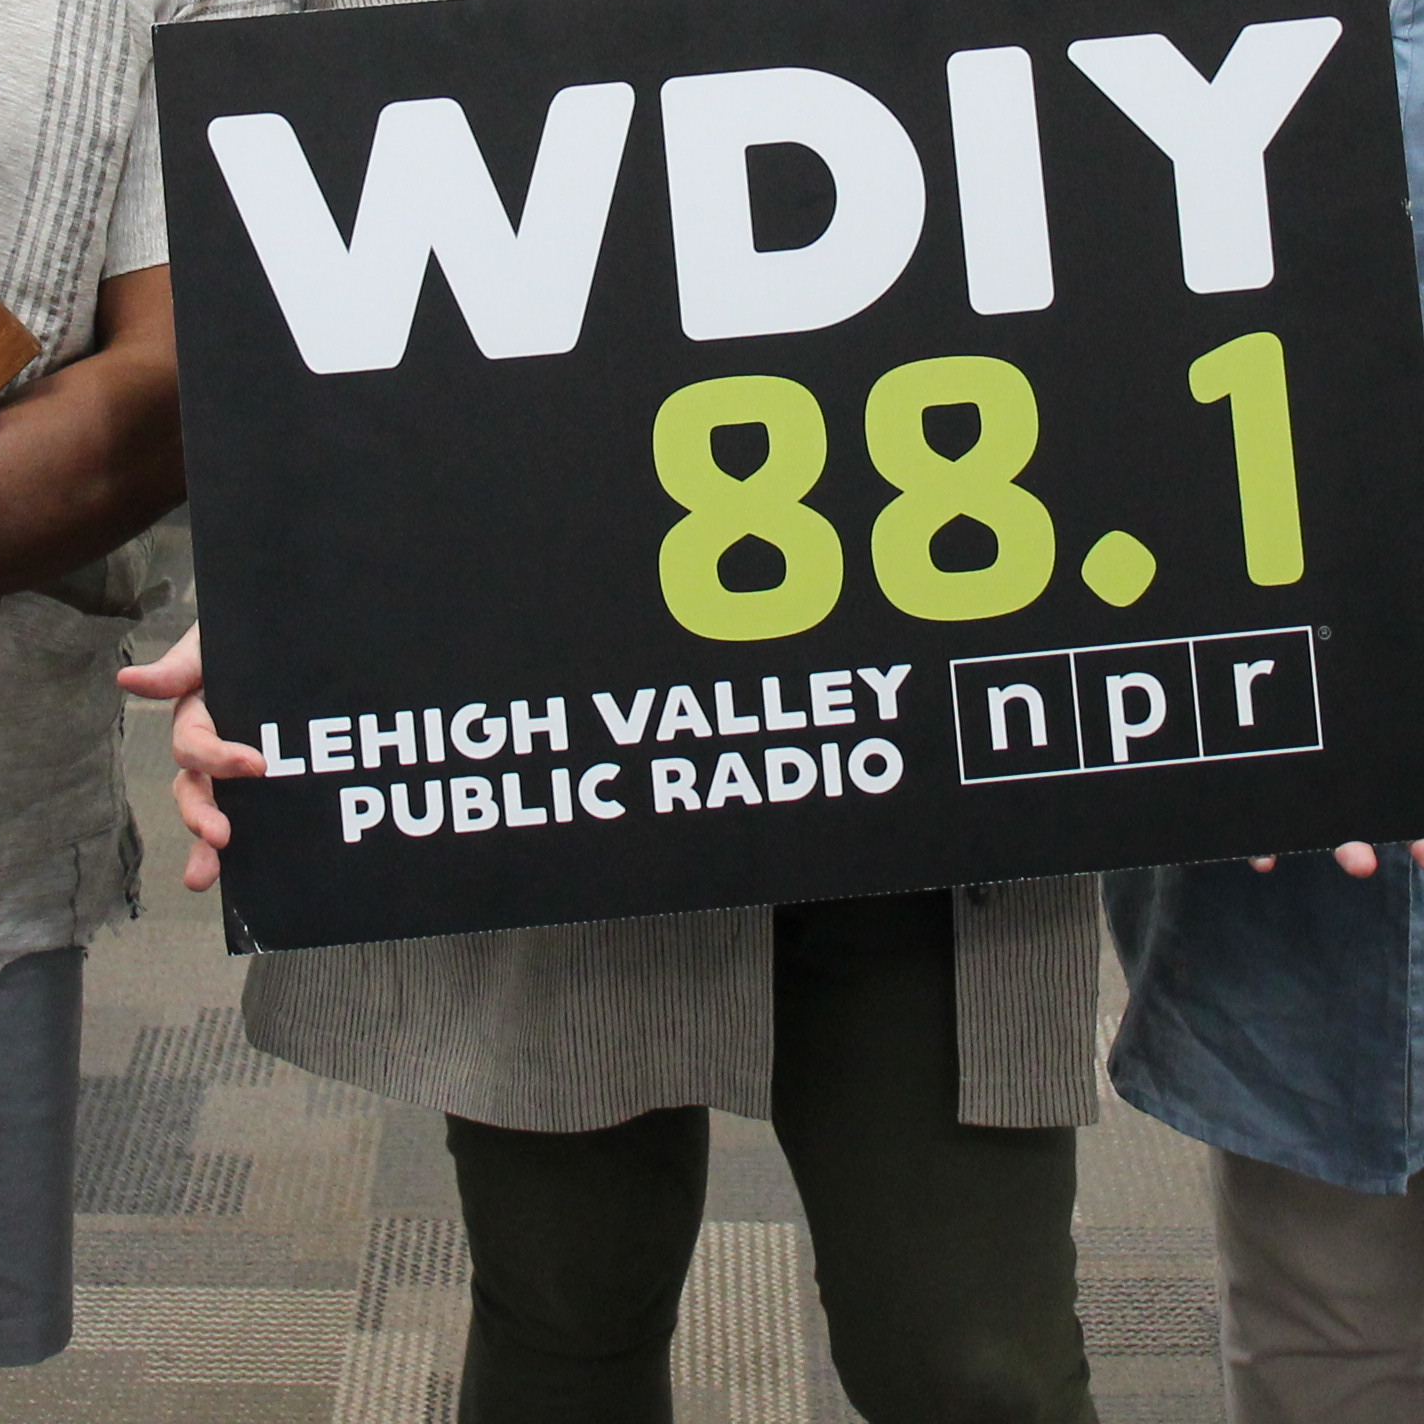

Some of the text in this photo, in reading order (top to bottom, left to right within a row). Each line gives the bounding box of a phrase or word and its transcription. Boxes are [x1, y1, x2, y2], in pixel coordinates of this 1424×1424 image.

[208, 17, 1342, 374] WDIY
[653, 332, 1304, 641] 88.1
[260, 664, 911, 778] LEHIGH VALLEY
[988, 660, 1274, 762] npr
[340, 738, 903, 842] PUBLIC RADIO
